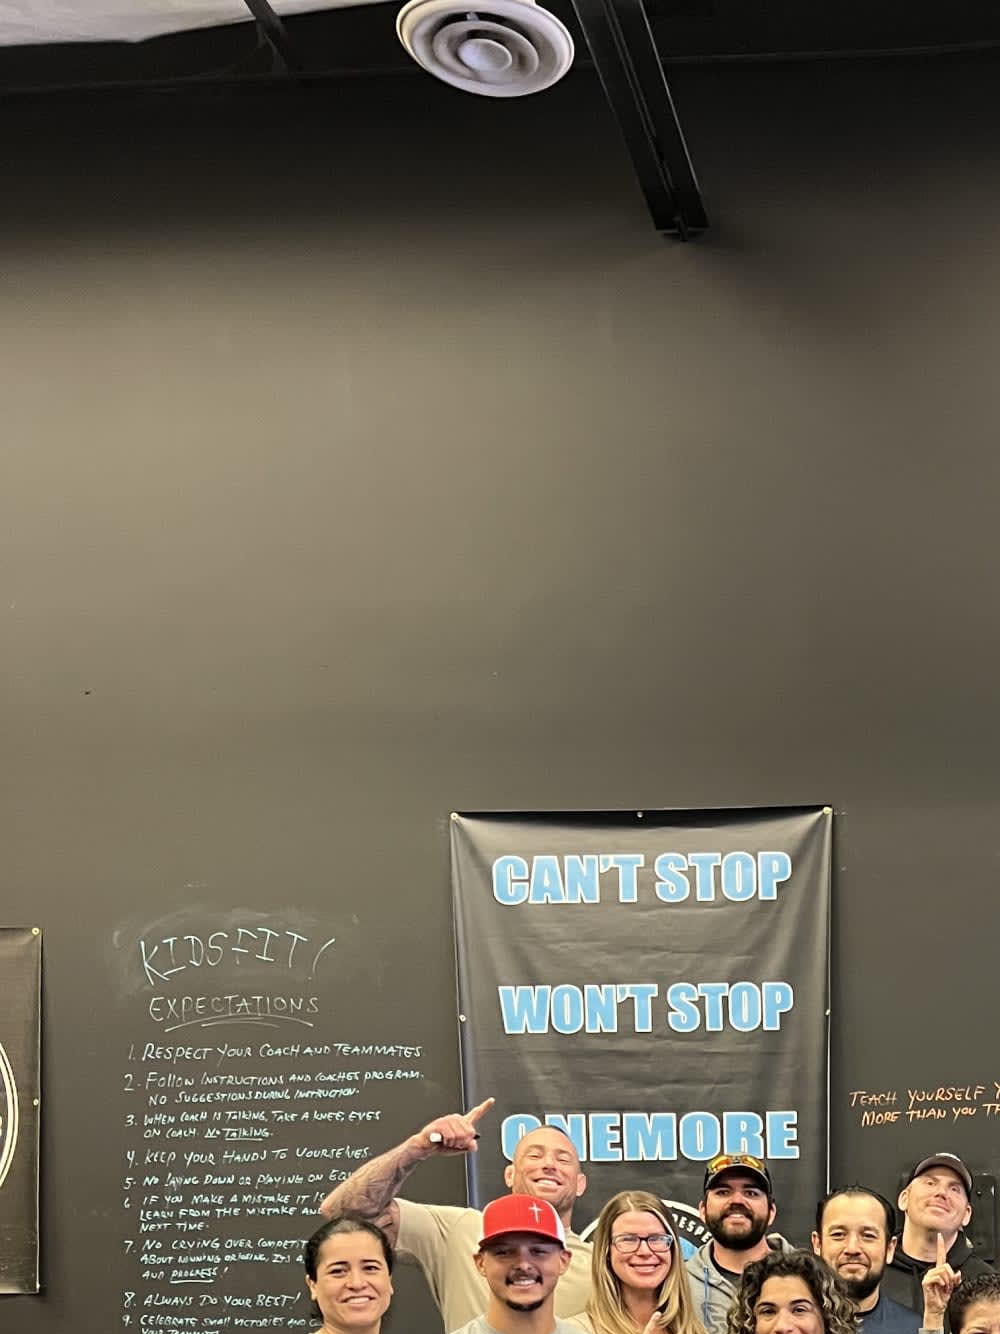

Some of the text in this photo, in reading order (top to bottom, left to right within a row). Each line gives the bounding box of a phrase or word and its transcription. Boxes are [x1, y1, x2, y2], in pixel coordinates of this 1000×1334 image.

[492, 851, 792, 905] CAN'T STOP
[150, 995, 318, 1022] EXPECTATIONS
[498, 982, 794, 1035] WON'T STOP
[142, 1043, 214, 1064] RESPECT
[217, 1043, 252, 1067] YOUR
[260, 1043, 300, 1058] COACH
[303, 1046, 330, 1056] AND
[201, 1072, 283, 1086] INSTRUCTIONS
[289, 1073, 311, 1082] AND
[149, 1094, 167, 1106] NO
[175, 1091, 253, 1103] SUGGESTIONS
[849, 1091, 898, 1107] TEACH
[907, 1086, 986, 1109] YOURSELF
[144, 1114, 175, 1126] WHEN
[180, 1111, 207, 1122] COACH
[213, 1111, 221, 1120] IS
[272, 1110, 298, 1122] TAKE
[301, 1111, 310, 1121] A
[862, 1111, 901, 1127] MORE
[906, 1109, 946, 1123] THAN
[952, 1107, 977, 1123] YOU
[144, 1128, 160, 1138] ON
[144, 1149, 176, 1166] KEEP
[184, 1152, 215, 1167] YOUR
[223, 1150, 267, 1164] HANDS
[272, 1148, 288, 1159] TO
[143, 1176, 159, 1186] NO
[203, 1174, 235, 1185] DOWN
[239, 1176, 251, 1185] OR
[307, 1174, 323, 1182] ON
[143, 1192, 324, 1208] IF YOU MAKE A MISTAKE IT IS
[140, 1209, 173, 1221] LEARN
[179, 1209, 210, 1219] FROM
[215, 1208, 240, 1218] THE
[246, 1207, 298, 1216] MISTAKE
[140, 1222, 172, 1233] NEXT
[143, 1240, 162, 1251] NO
[224, 1238, 253, 1248] OVER
[140, 1254, 175, 1264] ABOUT
[142, 1270, 164, 1279] AND
[144, 1293, 194, 1306] ALWAYS
[200, 1295, 218, 1306] DO
[224, 1296, 252, 1307] YOUR
